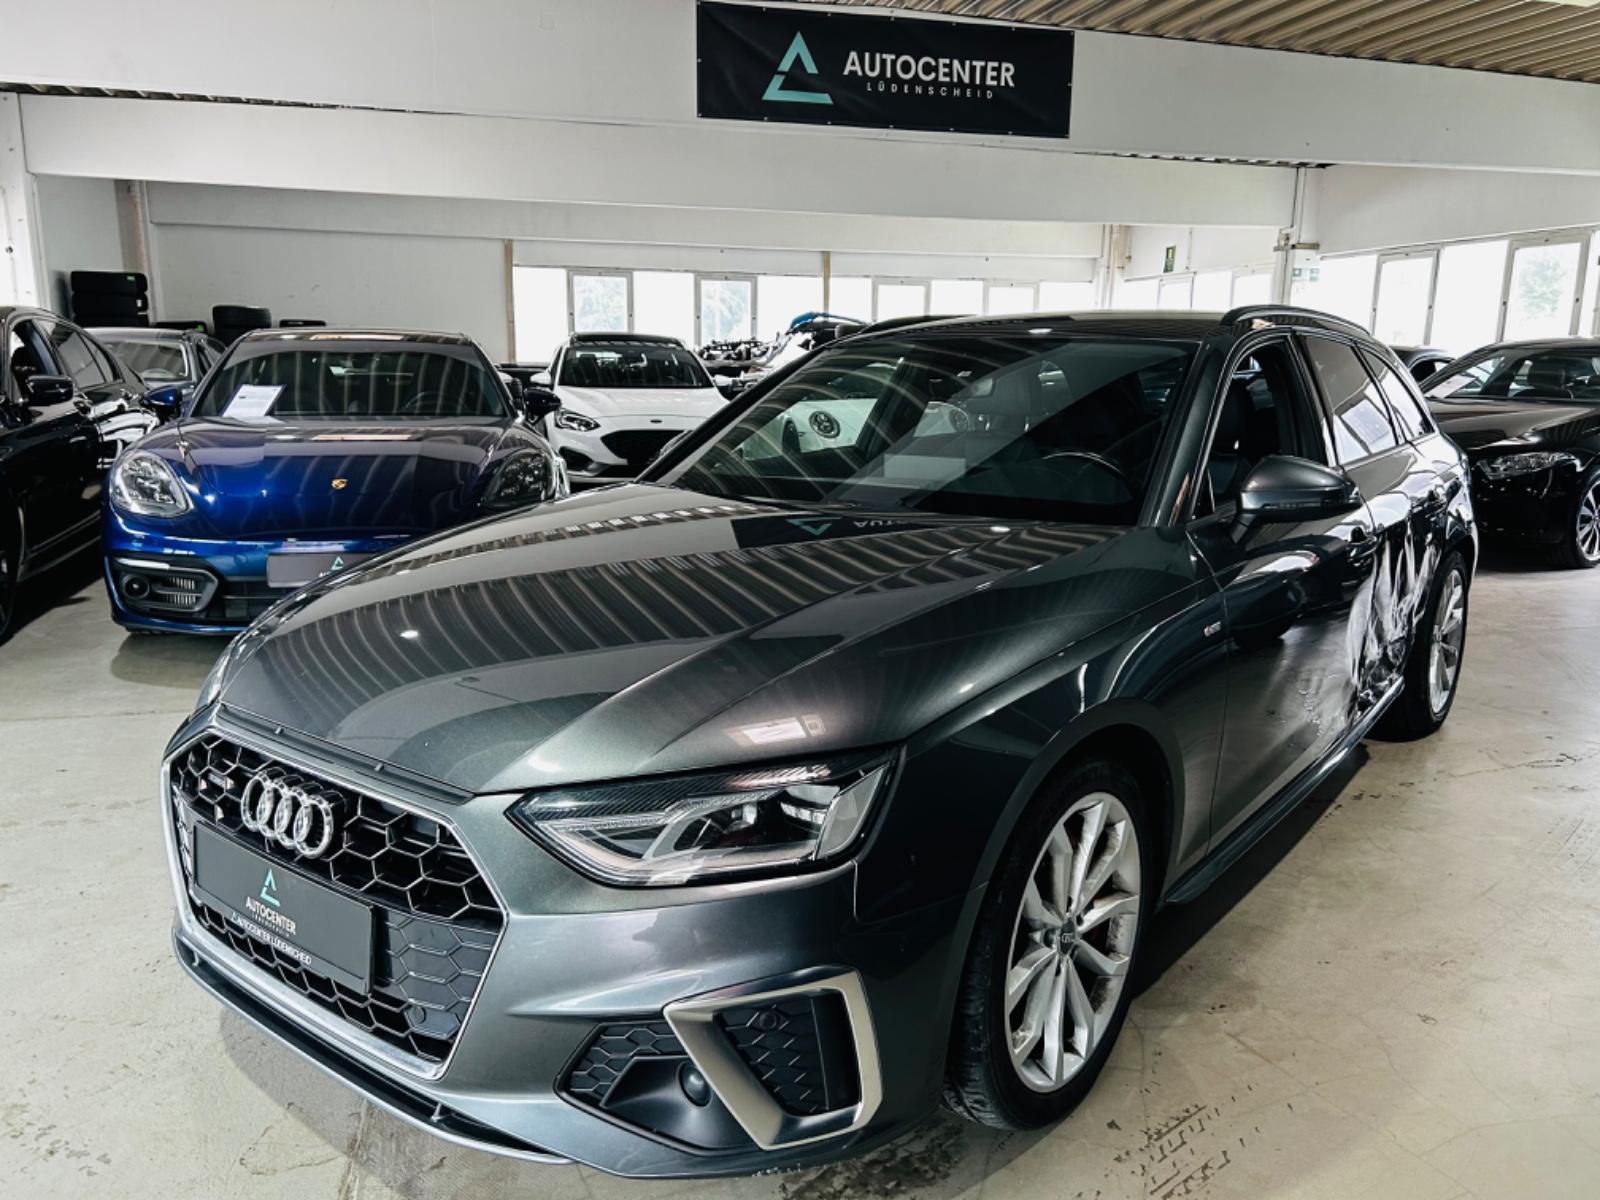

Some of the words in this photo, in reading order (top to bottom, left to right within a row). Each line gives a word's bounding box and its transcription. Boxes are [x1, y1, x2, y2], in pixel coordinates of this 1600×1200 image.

[842, 50, 1016, 88] AUTOCENTER
[866, 81, 994, 99] LÜDENSCHEID
[245, 896, 296, 936] AUTOCENTER
